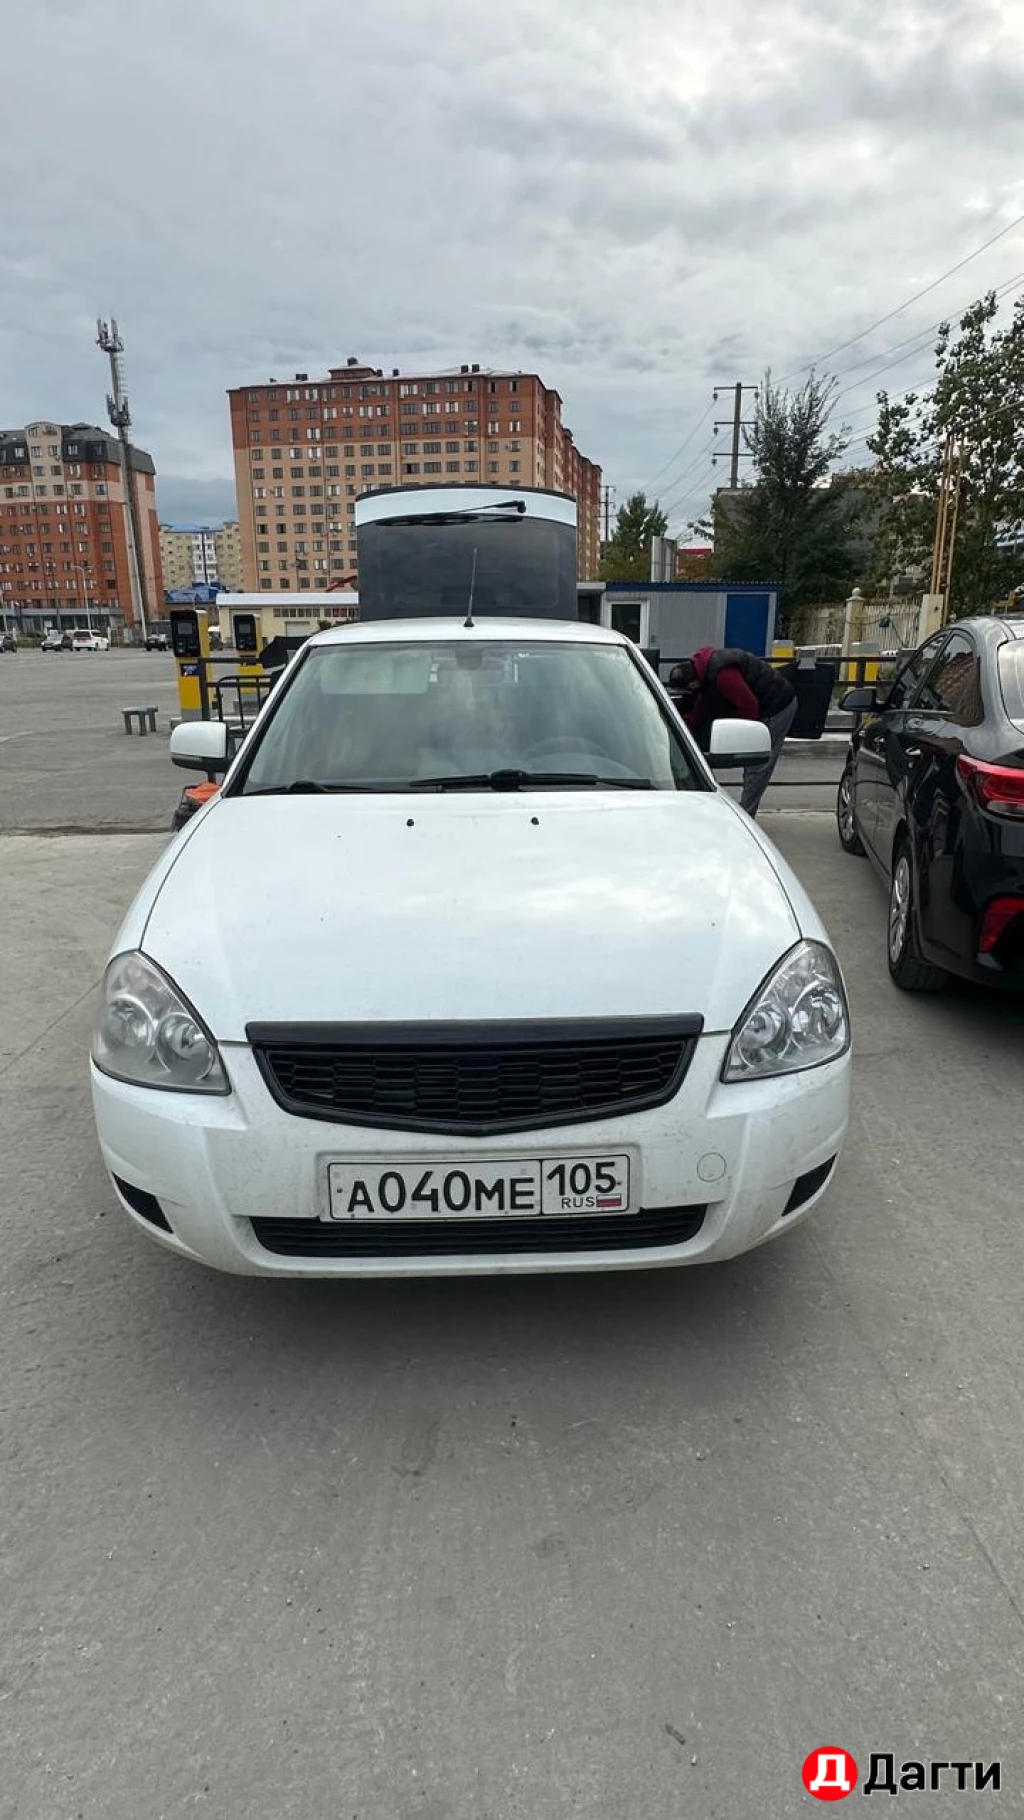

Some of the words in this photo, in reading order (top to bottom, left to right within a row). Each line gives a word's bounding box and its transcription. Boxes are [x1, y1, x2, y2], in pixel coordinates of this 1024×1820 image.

[347, 1169, 534, 1213] А040МЕ
[546, 1161, 617, 1196] 105
[561, 1195, 595, 1208] RUS
